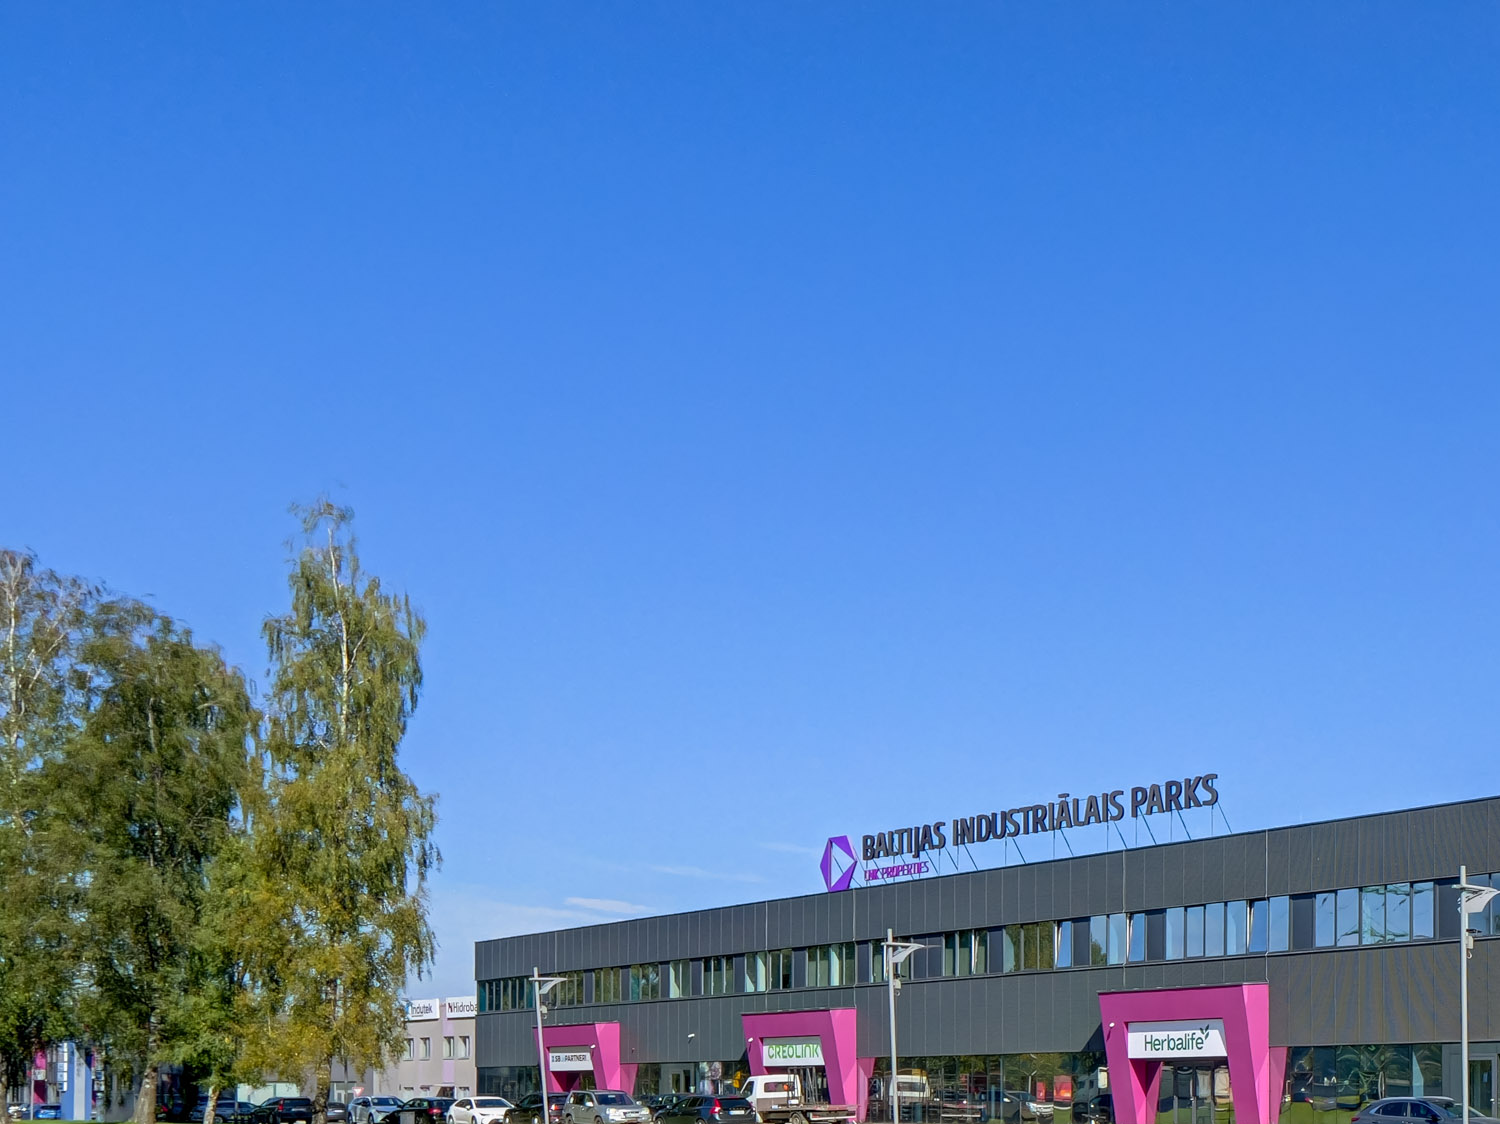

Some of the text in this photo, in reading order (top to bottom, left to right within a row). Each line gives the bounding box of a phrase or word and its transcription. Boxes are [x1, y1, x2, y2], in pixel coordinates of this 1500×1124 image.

[862, 773, 1218, 860] BALTIJAS INDUSTRIĀLAIS PARKS
[411, 1003, 433, 1014] Indutek
[1144, 1032, 1204, 1051] Herbalife
